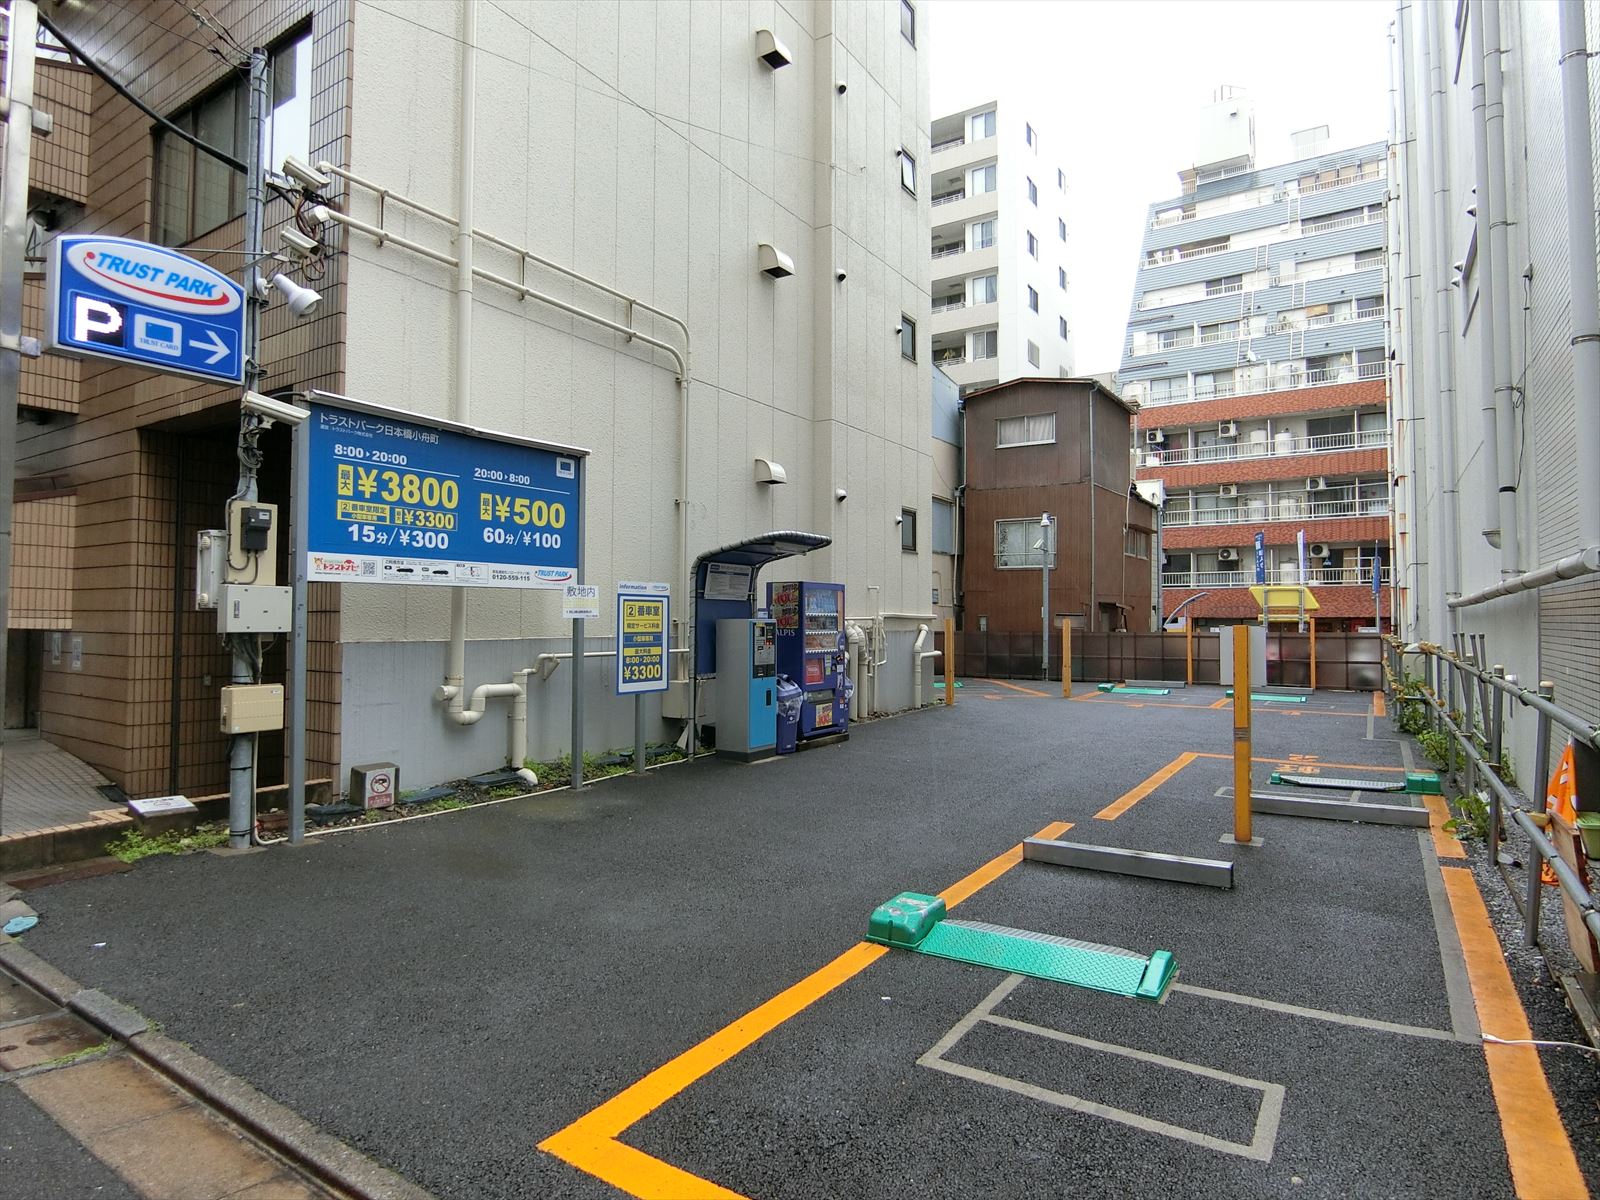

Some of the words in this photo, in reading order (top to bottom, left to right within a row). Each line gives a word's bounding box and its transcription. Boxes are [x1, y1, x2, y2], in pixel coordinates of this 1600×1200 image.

[97, 252, 164, 282] TRUST
[164, 272, 218, 298] PARK
[73, 295, 123, 343] P
[140, 337, 159, 348] TRUST
[160, 342, 179, 351] CARD
[334, 444, 364, 458] 8:00
[371, 450, 408, 465] 20:00
[474, 467, 503, 481] 20:00
[509, 473, 530, 485] 8:00
[340, 469, 351, 491] 最大
[357, 466, 459, 509] ¥3800
[404, 509, 455, 529] ¥3300
[482, 497, 491, 516] 最大
[495, 494, 566, 529] ¥500
[537, 569, 555, 577] TRUST
[566, 586, 596, 598] 敷地内
[624, 664, 661, 680] ¥3300
